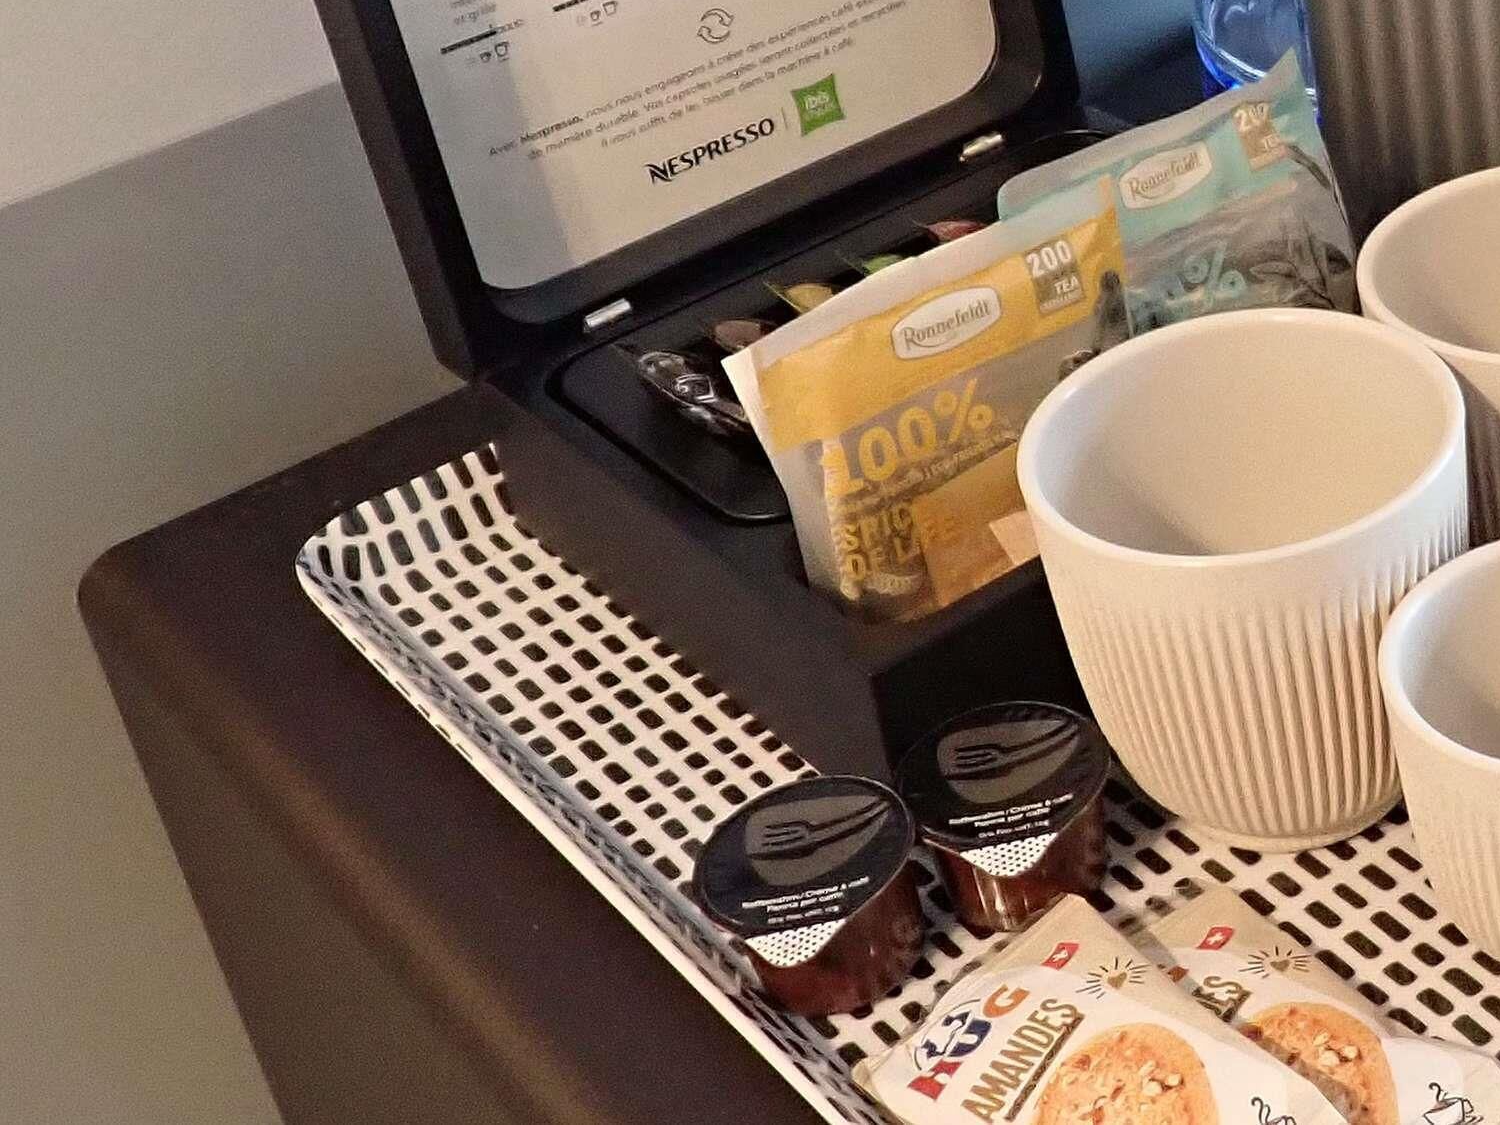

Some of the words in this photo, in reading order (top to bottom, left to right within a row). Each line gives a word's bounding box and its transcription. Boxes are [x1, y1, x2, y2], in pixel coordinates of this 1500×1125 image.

[646, 118, 775, 182] NESPRESSO
[1026, 239, 1073, 277] 200
[1053, 275, 1081, 297] TEA
[903, 298, 992, 351] Ronnefeldt
[821, 377, 993, 497] 100%
[961, 997, 1079, 1124] AMANDES
